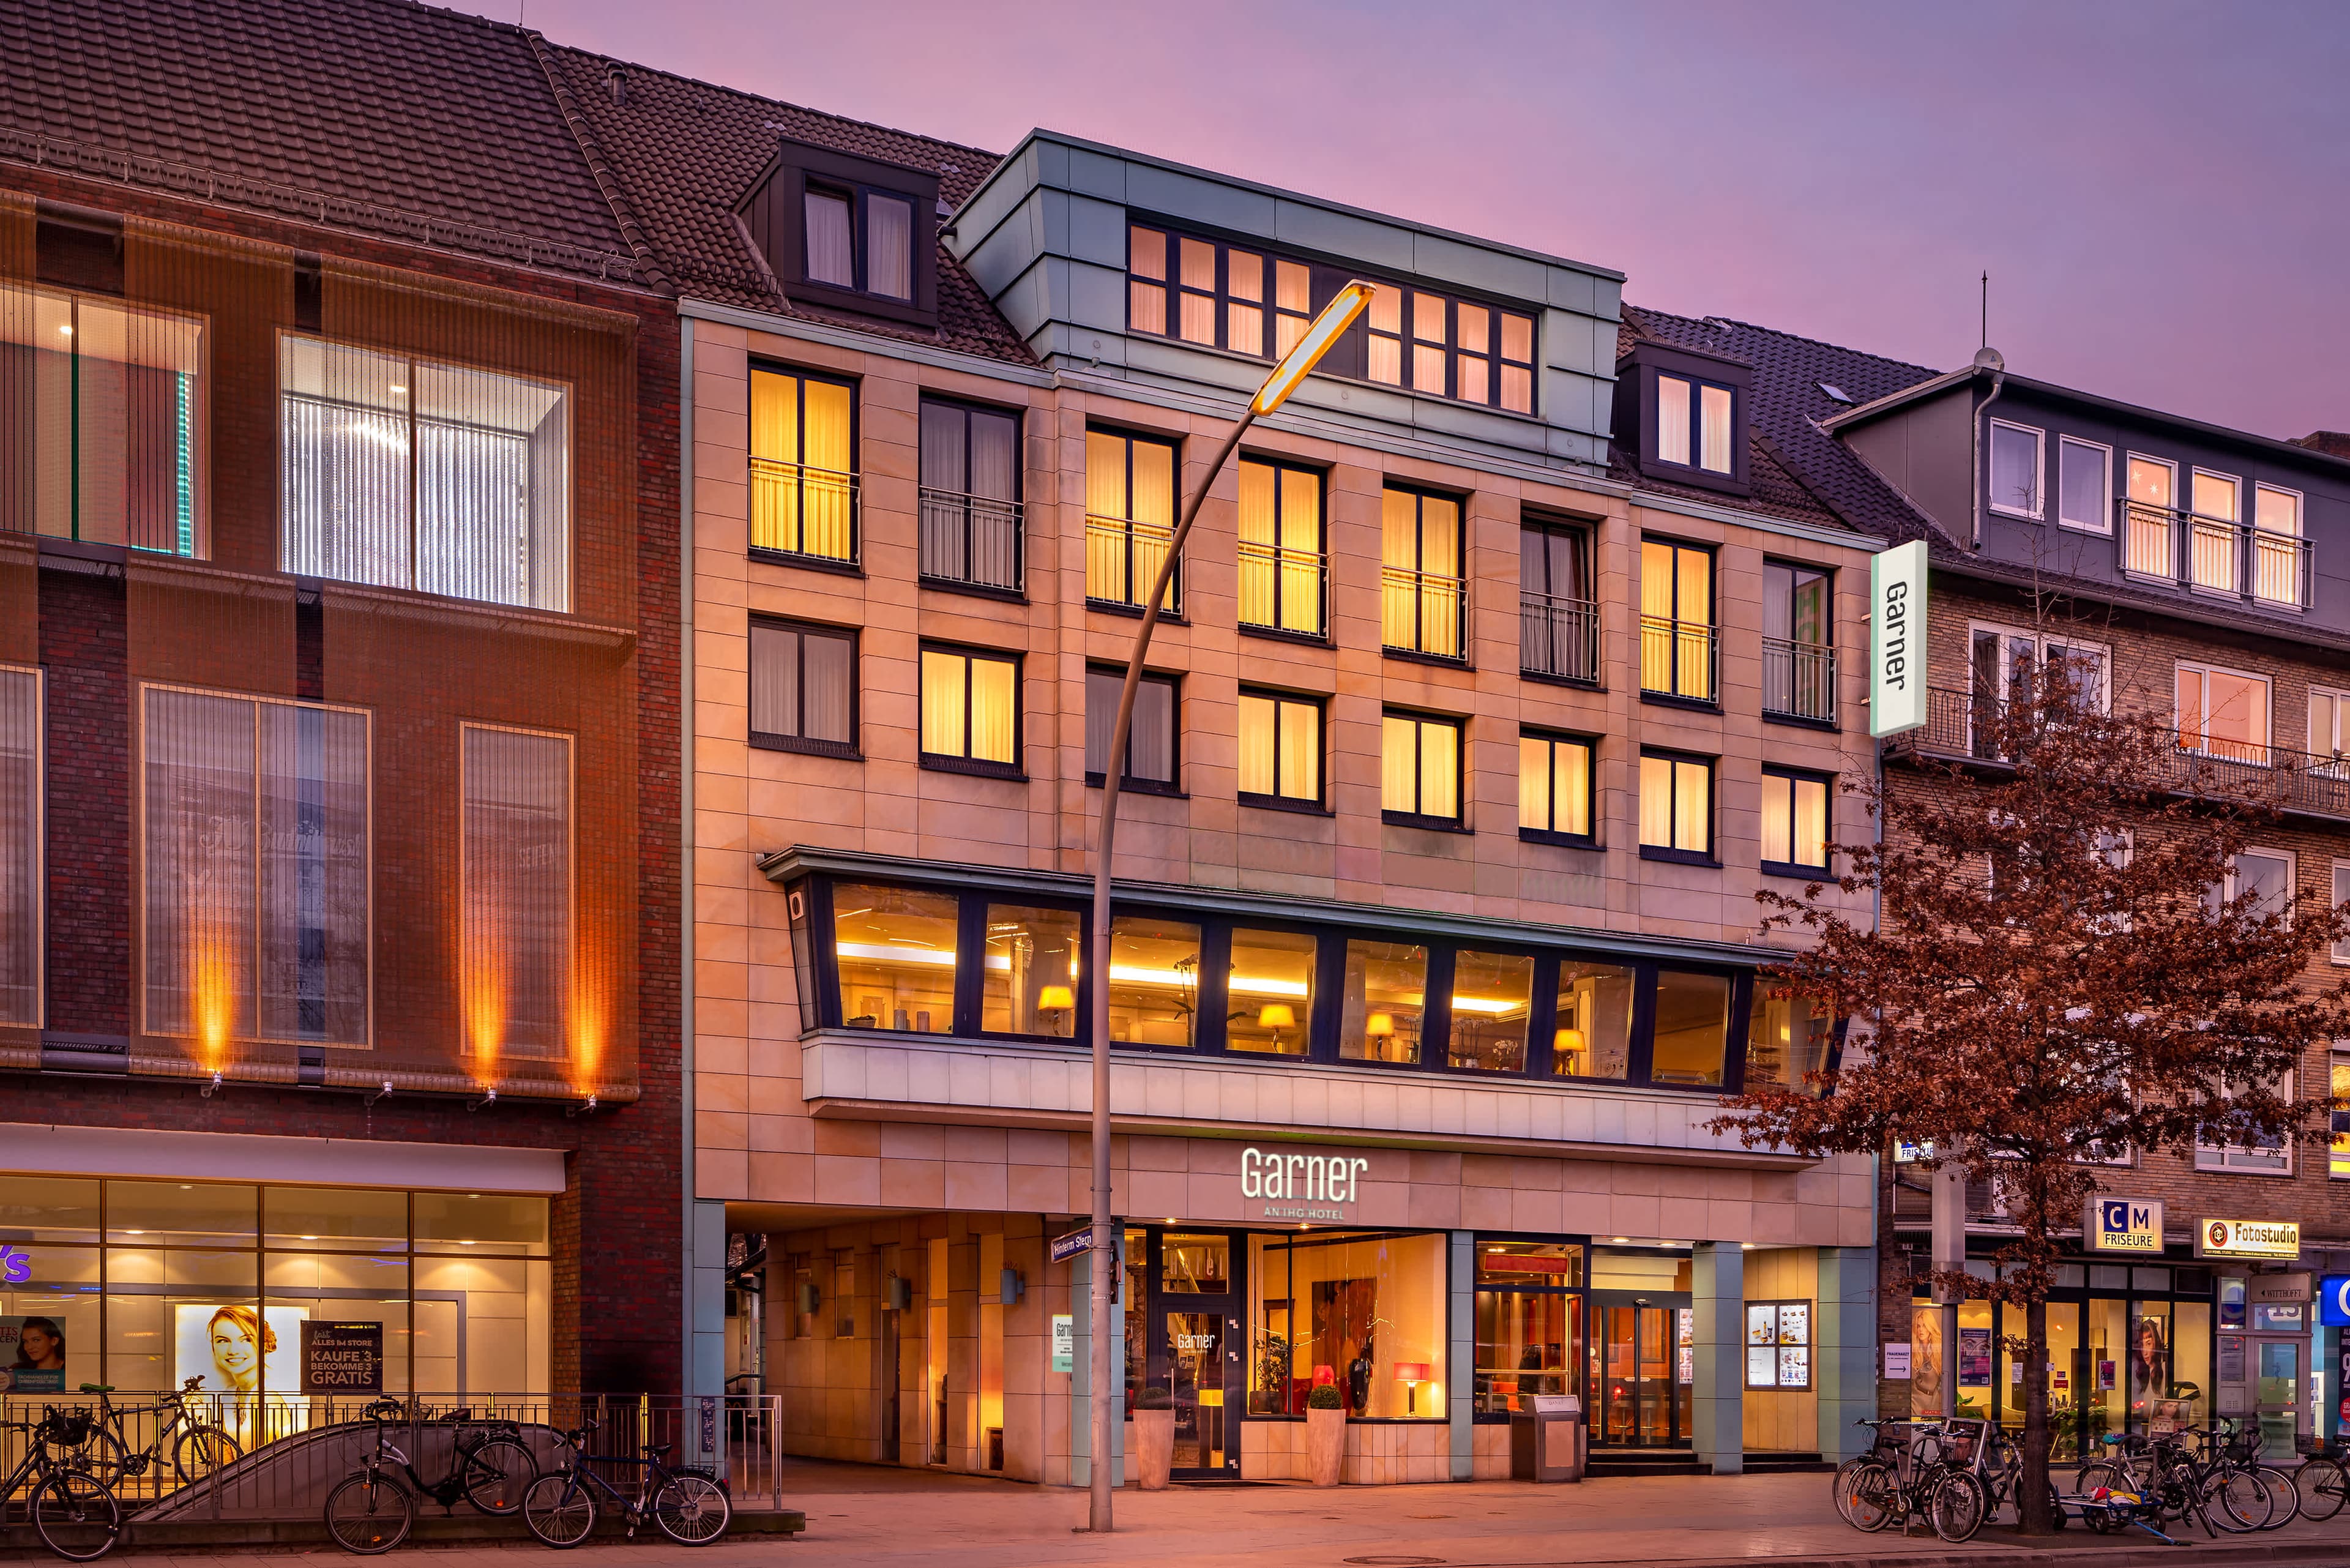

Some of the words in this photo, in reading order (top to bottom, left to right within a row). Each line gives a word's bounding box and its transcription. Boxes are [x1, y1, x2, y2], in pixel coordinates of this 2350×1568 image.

[1886, 581, 1908, 691] Garner
[1241, 1148, 1368, 1203] Garner
[1264, 1207, 1279, 1217] AN
[1283, 1208, 1305, 1218] IHG
[1308, 1209, 1345, 1220] HOTEL
[2109, 1206, 2123, 1229] C
[2133, 1208, 2149, 1230] M
[2105, 1233, 2153, 1247] FRISEURE
[2235, 1222, 2296, 1244] Fotostudio
[1054, 1241, 1075, 1256] Hinterm
[1075, 1235, 1092, 1248] Stern
[2266, 1287, 2302, 1298] WITTHÖFFT
[1177, 1334, 1215, 1348] Garner
[310, 1351, 360, 1362] KAUFE
[364, 1351, 372, 1362] 3
[310, 1371, 373, 1384] GRATIS
